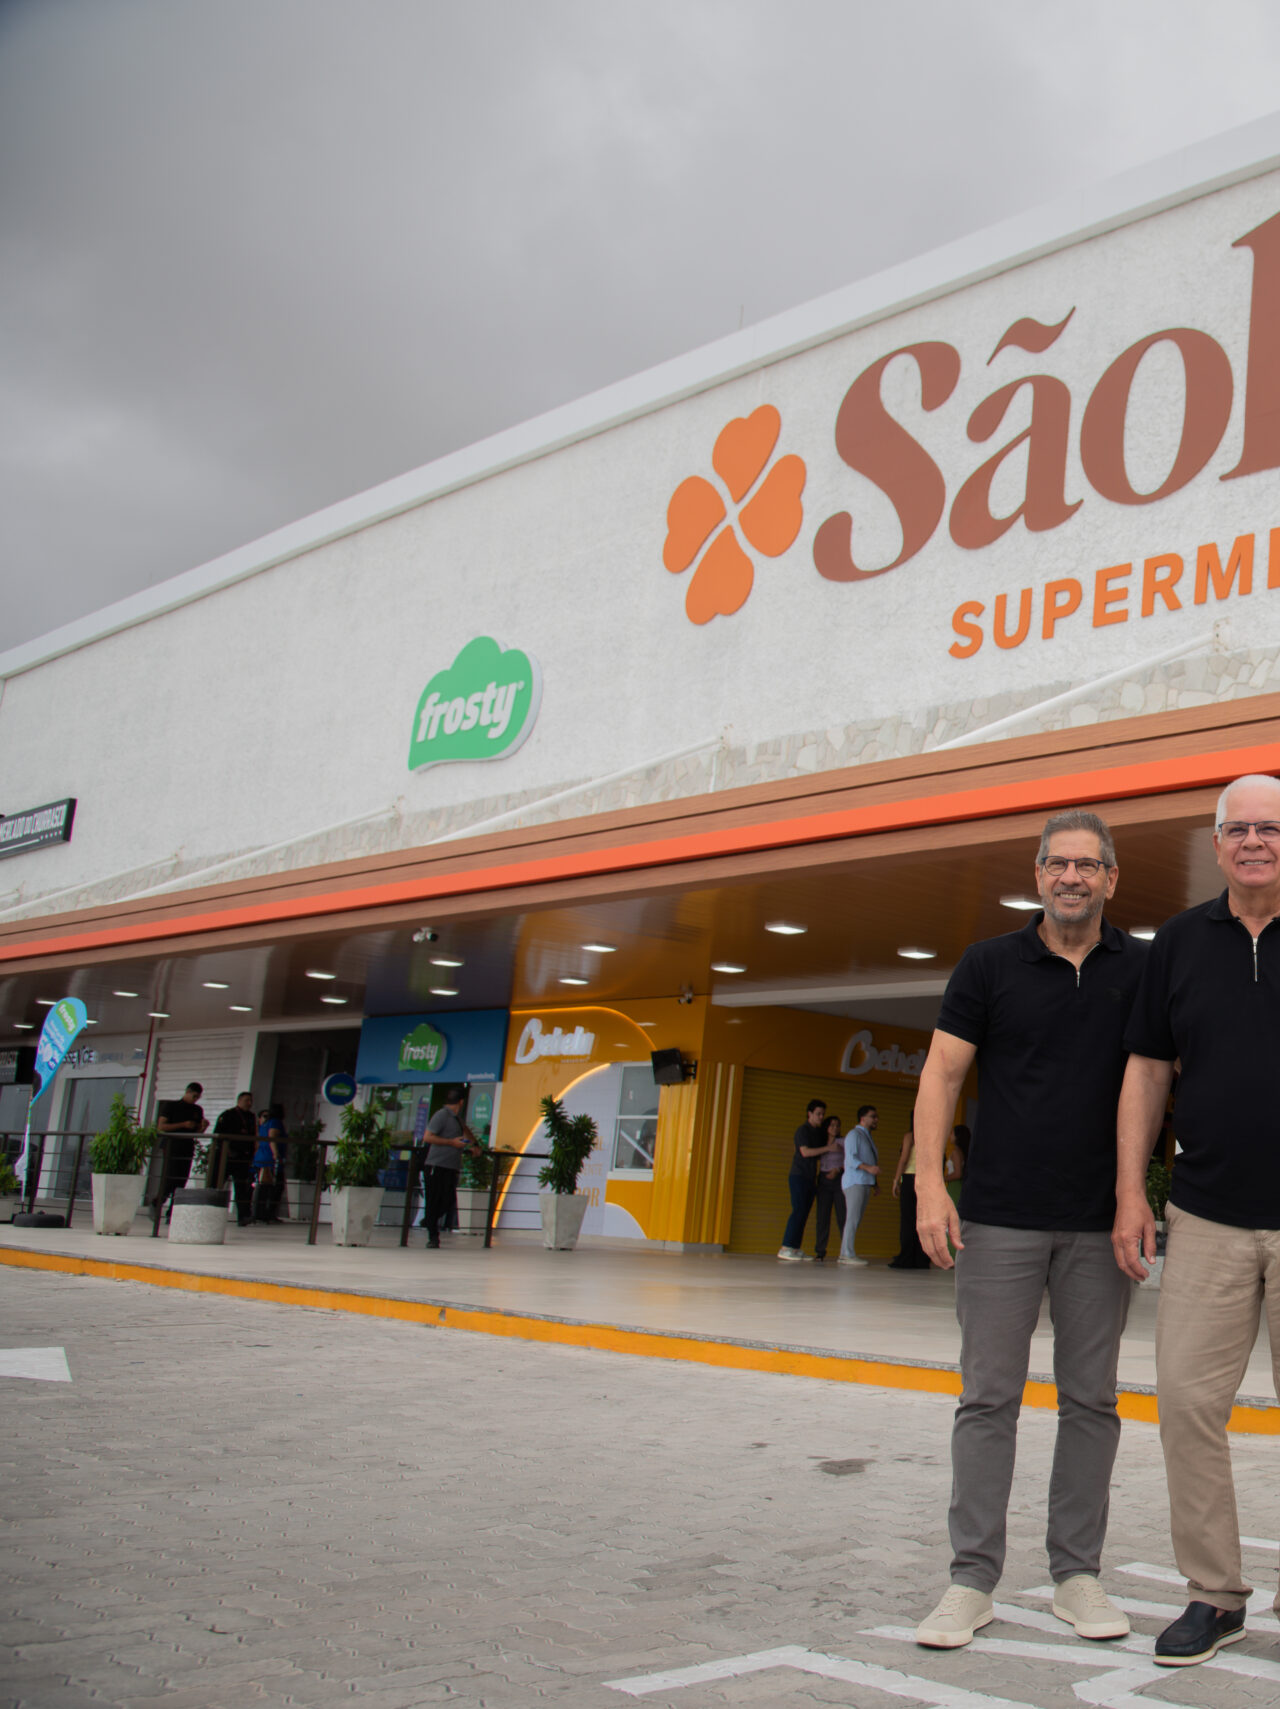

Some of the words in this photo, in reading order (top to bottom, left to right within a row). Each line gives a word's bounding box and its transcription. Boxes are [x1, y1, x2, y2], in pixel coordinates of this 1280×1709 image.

[415, 680, 518, 743] frosty
[33, 804, 67, 833] CHURRASCO
[403, 1042, 438, 1066] frosty
[840, 1029, 927, 1076] Bebel
